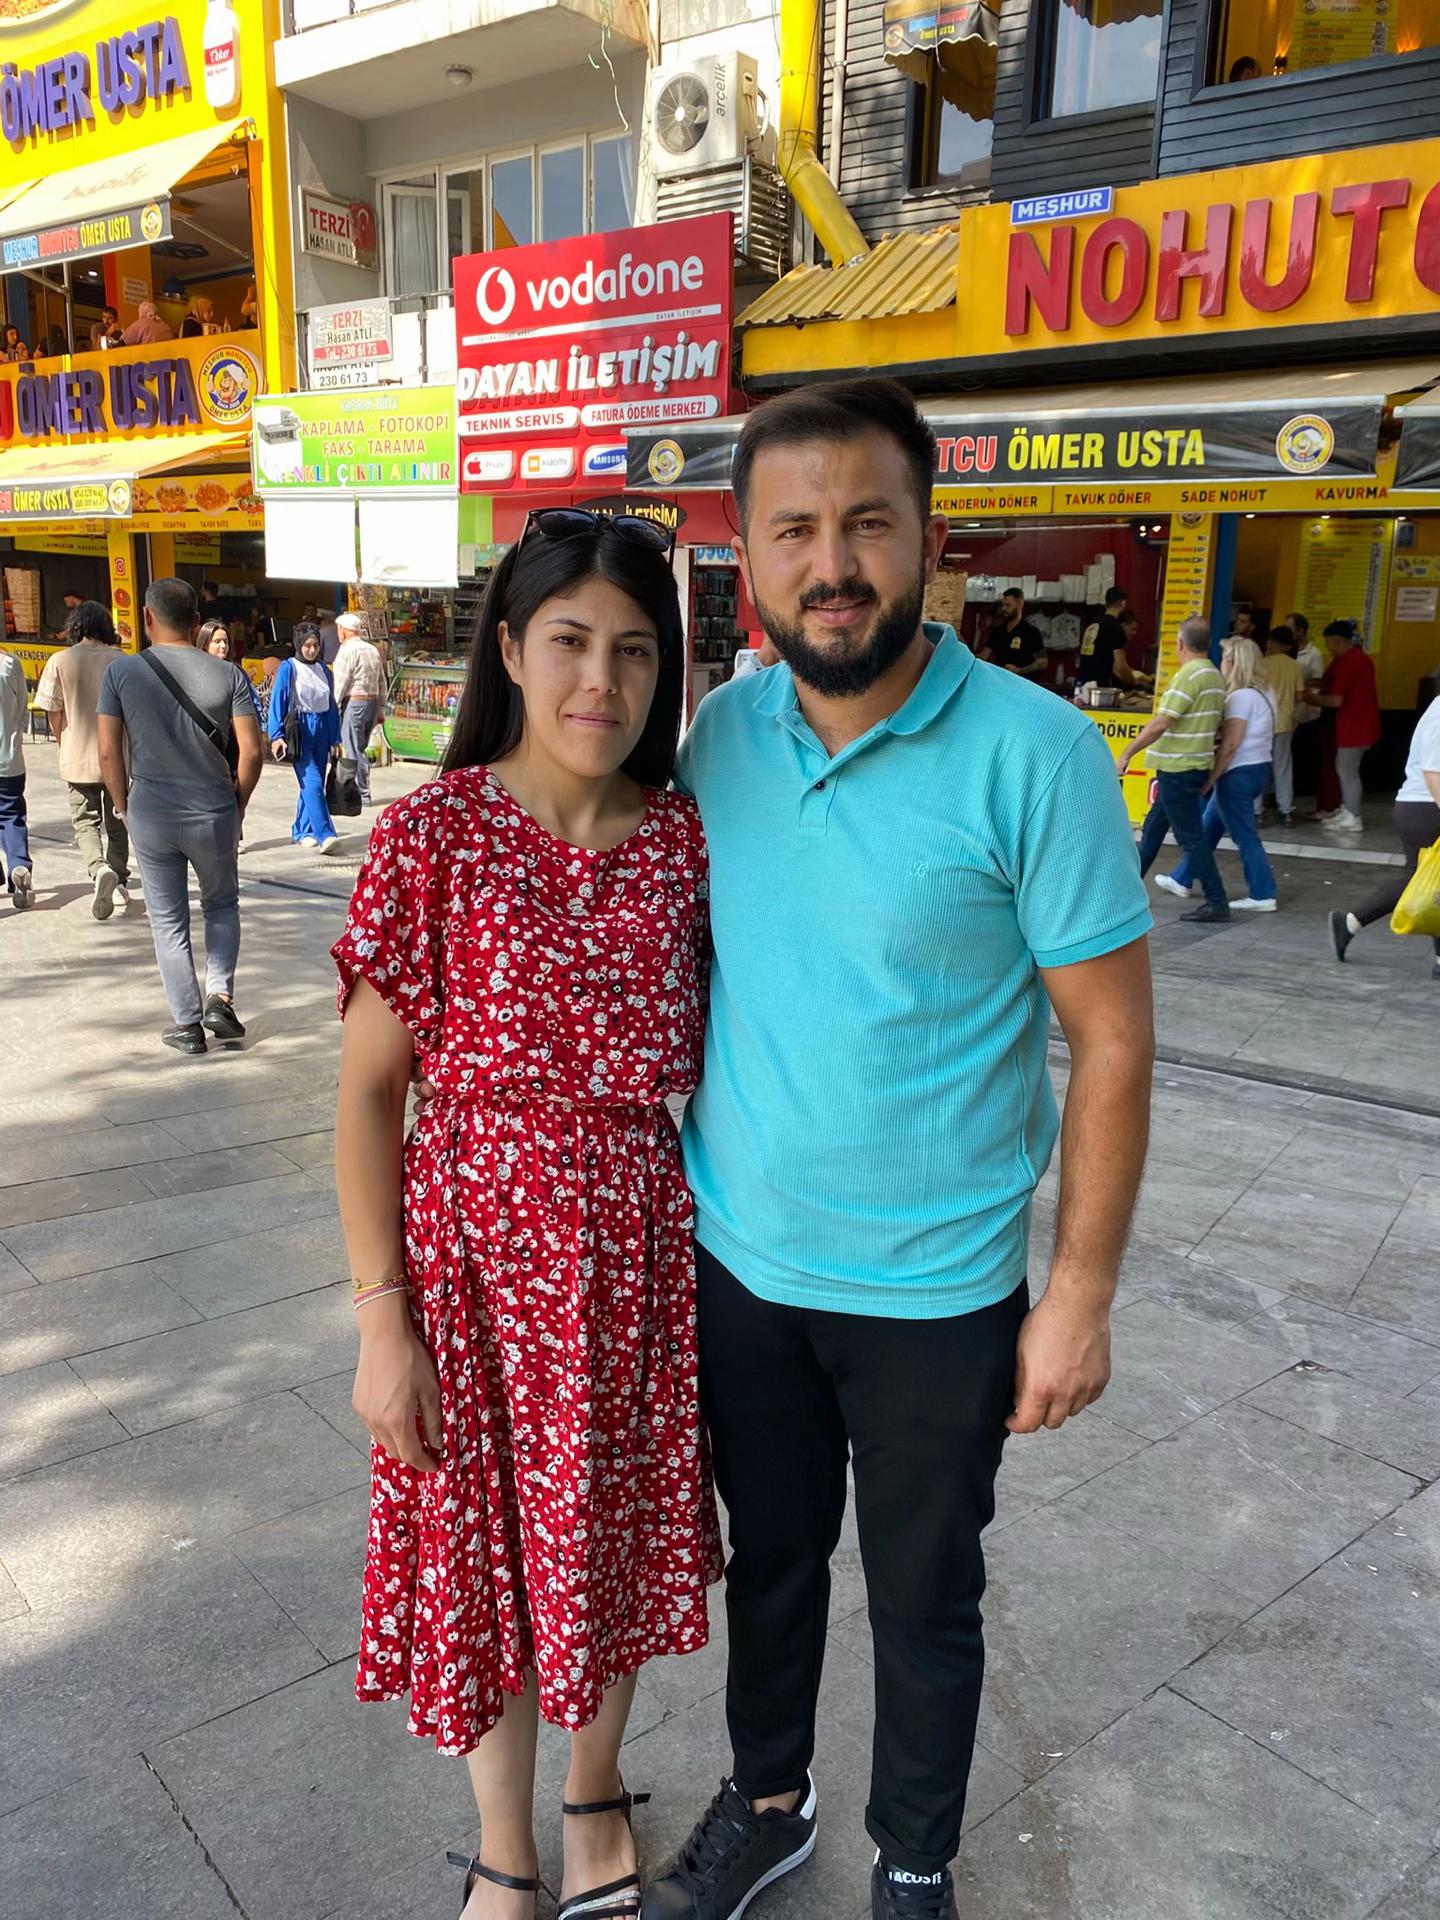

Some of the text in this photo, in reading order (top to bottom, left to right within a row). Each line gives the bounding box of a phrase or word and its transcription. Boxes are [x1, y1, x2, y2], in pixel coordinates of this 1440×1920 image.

[0, 16, 191, 142] ÖMER USTA
[1017, 192, 1102, 217] MEŞHUR
[80, 221, 106, 248] ÖMER
[108, 215, 131, 242] USTA
[309, 207, 350, 238] TERZİ
[309, 233, 335, 255] HASAN
[526, 253, 703, 311] vodafone
[327, 327, 372, 344] Hasan ATLI
[457, 331, 720, 401] DAYAN İLETİŞİM
[320, 372, 368, 387] 230 61 73
[17, 362, 107, 437] ÖMER
[110, 358, 202, 430] USTA
[591, 399, 706, 422] FATURA ÖDEME MERKEZİ
[302, 411, 449, 436] KAPLAMA FOTOKOPİ
[323, 439, 426, 456] FAKS TARAMA
[1007, 427, 1104, 470] ÖMER
[1116, 428, 1205, 468] USTA
[337, 463, 382, 487] ÇIKTI
[389, 463, 450, 481] ALINIR
[13, 486, 41, 512] ÖMER
[43, 488, 70, 511] USTA
[999, 494, 1038, 508] DÖNER
[1065, 493, 1105, 505] TAVUK
[1109, 490, 1151, 504] DÖNER
[1181, 490, 1216, 502] SADE
[1219, 489, 1266, 501] NOHUT
[1315, 486, 1388, 500] KAVURMA
